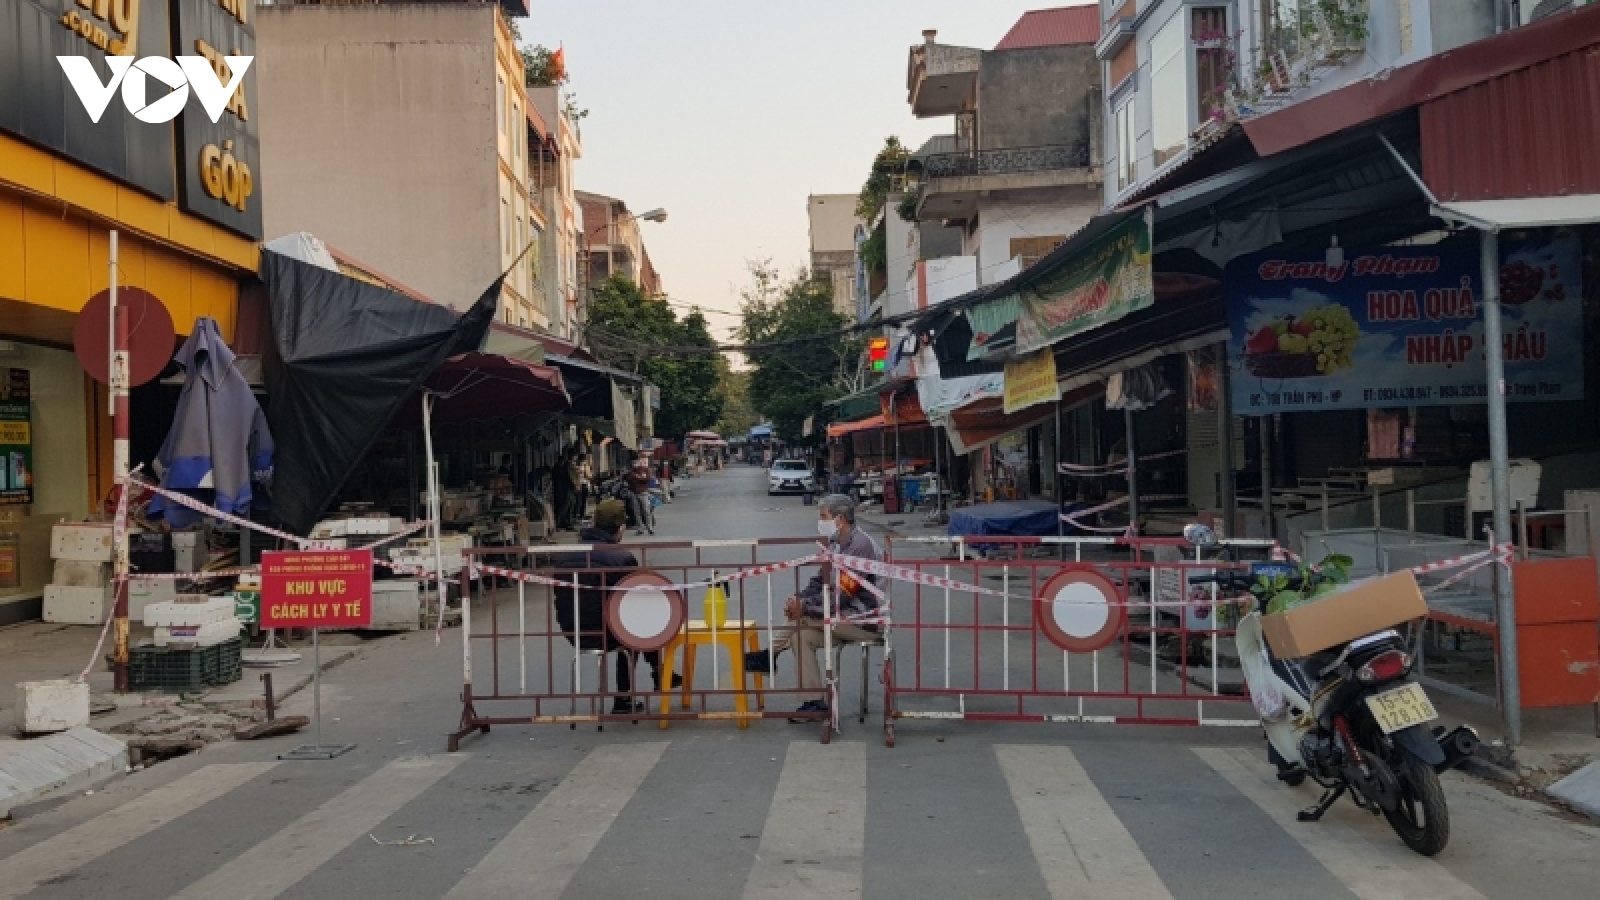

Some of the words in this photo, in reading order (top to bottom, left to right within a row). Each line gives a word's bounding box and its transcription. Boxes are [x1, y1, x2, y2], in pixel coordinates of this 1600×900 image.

[200, 139, 253, 212] GÓP
[1368, 290, 1420, 322] HOA
[1424, 275, 1476, 319] QUẢ
[1407, 329, 1473, 369] NHẬP
[1482, 321, 1547, 361] HẨU
[271, 602, 309, 619] CÁCH
[313, 603, 328, 618] LY
[332, 603, 341, 618] Y
[344, 598, 363, 617] TẾ
[285, 579, 315, 595] KHU
[318, 578, 347, 598] VỰC
